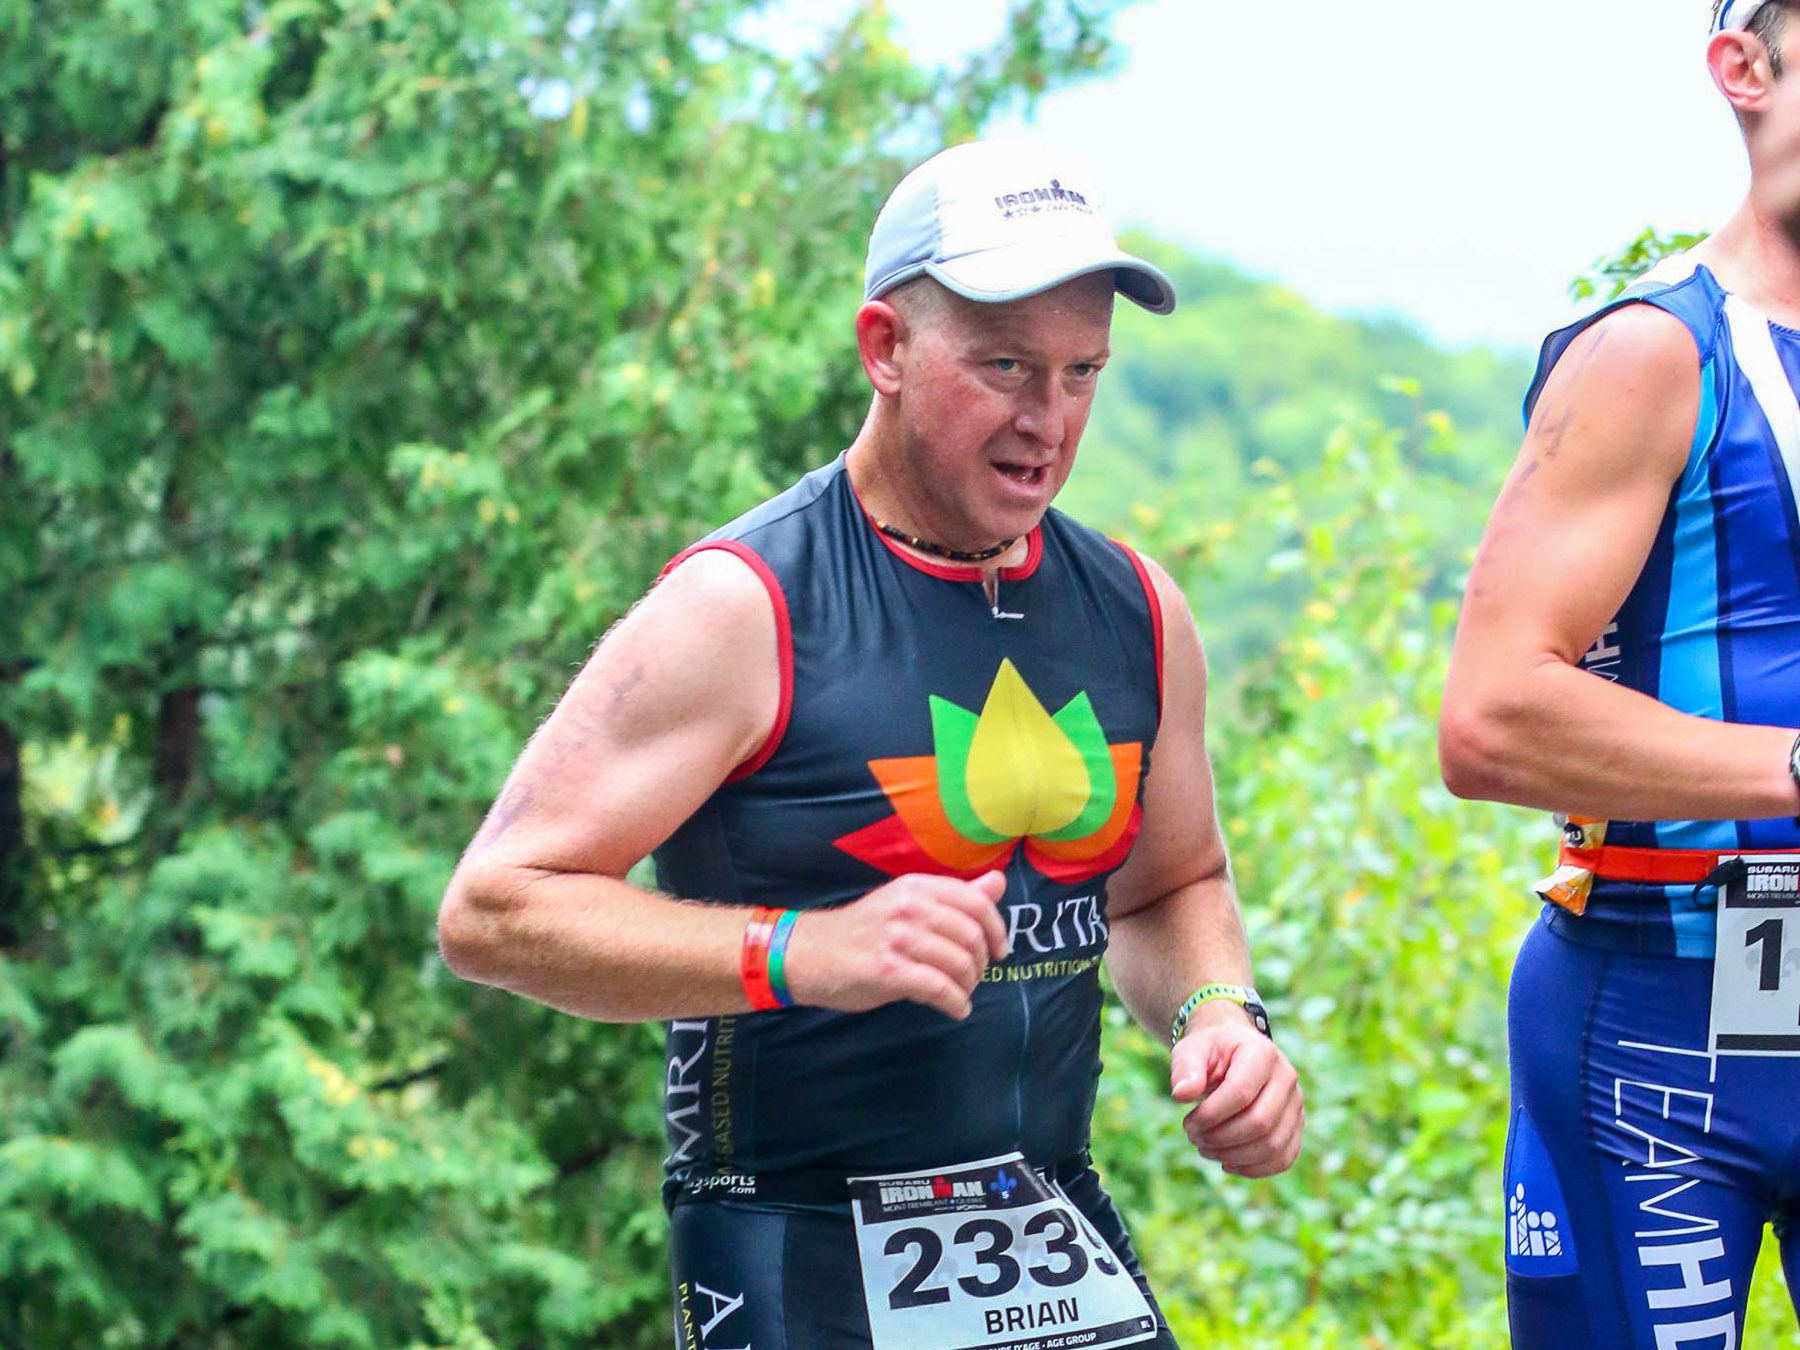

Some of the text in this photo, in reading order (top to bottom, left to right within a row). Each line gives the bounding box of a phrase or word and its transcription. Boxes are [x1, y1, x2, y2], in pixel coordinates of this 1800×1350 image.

[1747, 865, 1800, 874] SUBARU
[1747, 874, 1800, 892] IRON
[1745, 919, 1783, 991] 1
[878, 1179, 931, 1187] SUBARU
[880, 1177, 986, 1205] IRONMAN
[984, 1297, 1079, 1335] BRIAN
[1047, 1337, 1065, 1348] AGE
[1066, 1332, 1097, 1345] GROUP
